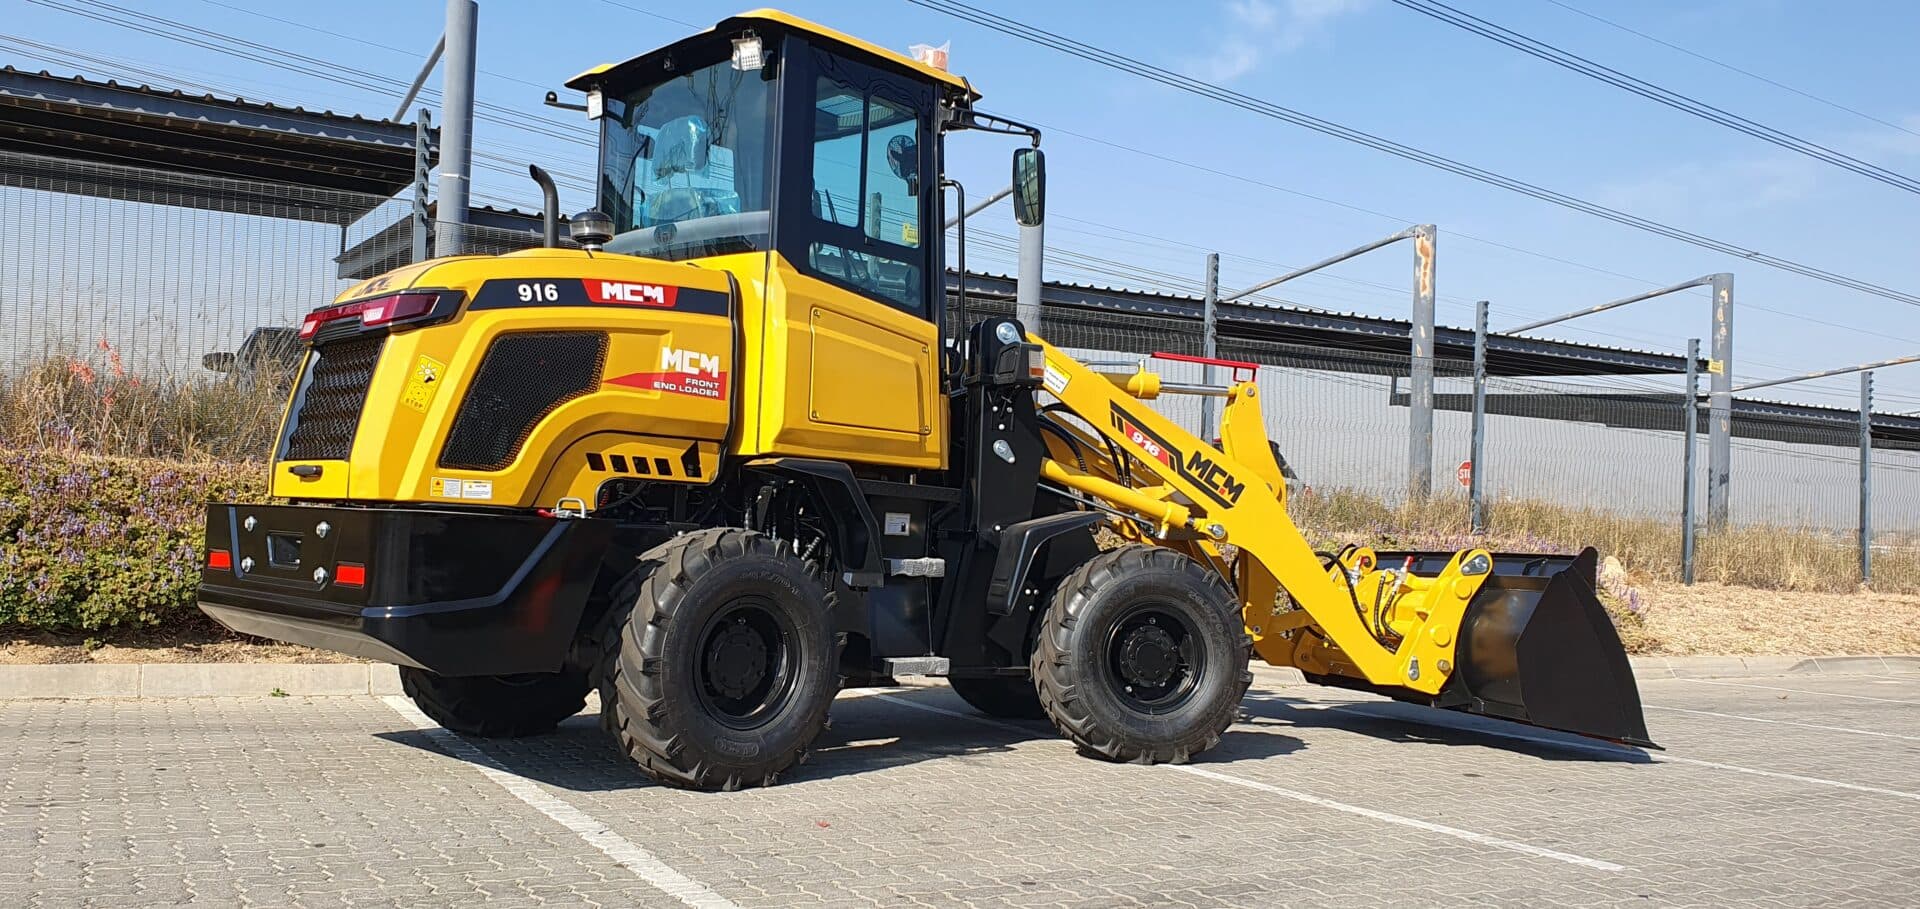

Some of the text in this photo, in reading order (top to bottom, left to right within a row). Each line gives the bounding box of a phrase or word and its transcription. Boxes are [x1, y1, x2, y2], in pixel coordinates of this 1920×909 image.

[518, 281, 664, 303] 916 MCM
[661, 346, 720, 378] MCM
[653, 381, 719, 397] END LOADER
[685, 378, 720, 389] FRONT
[1131, 431, 1160, 457] 916
[1186, 450, 1246, 504] MCM
